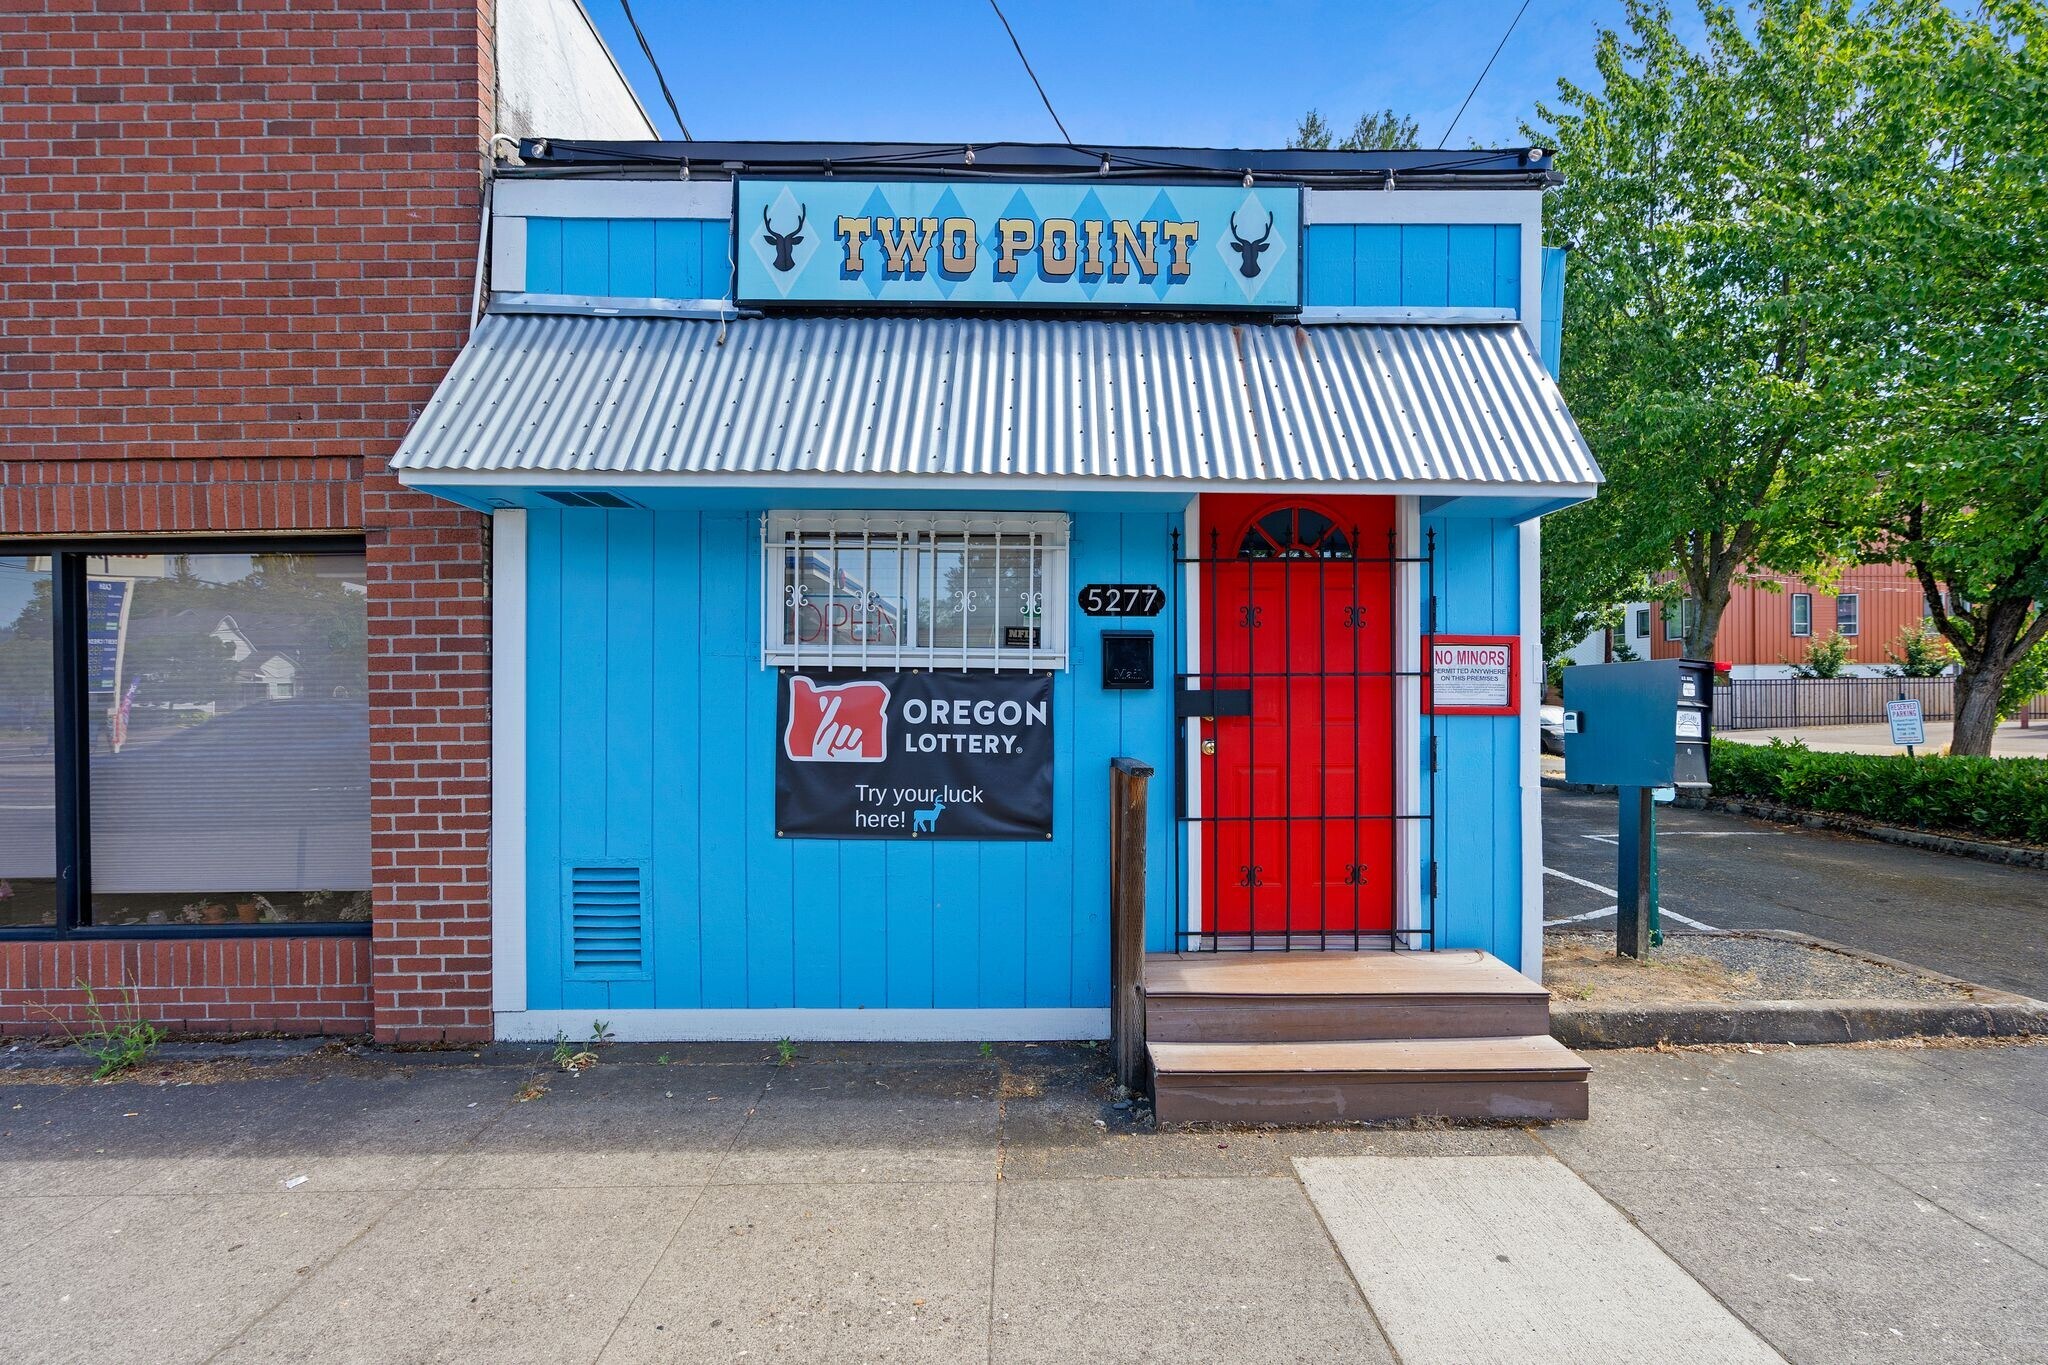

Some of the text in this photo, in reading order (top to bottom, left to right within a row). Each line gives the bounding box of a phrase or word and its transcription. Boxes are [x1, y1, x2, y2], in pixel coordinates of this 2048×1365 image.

[835, 215, 1199, 284] TWO POINT
[1087, 589, 1158, 611] 5277
[791, 603, 900, 641] OPEN
[1435, 650, 1504, 666] NO MINORS
[902, 698, 1047, 726] OREGON
[855, 784, 984, 806] Try your luck
[855, 810, 906, 828] here!
